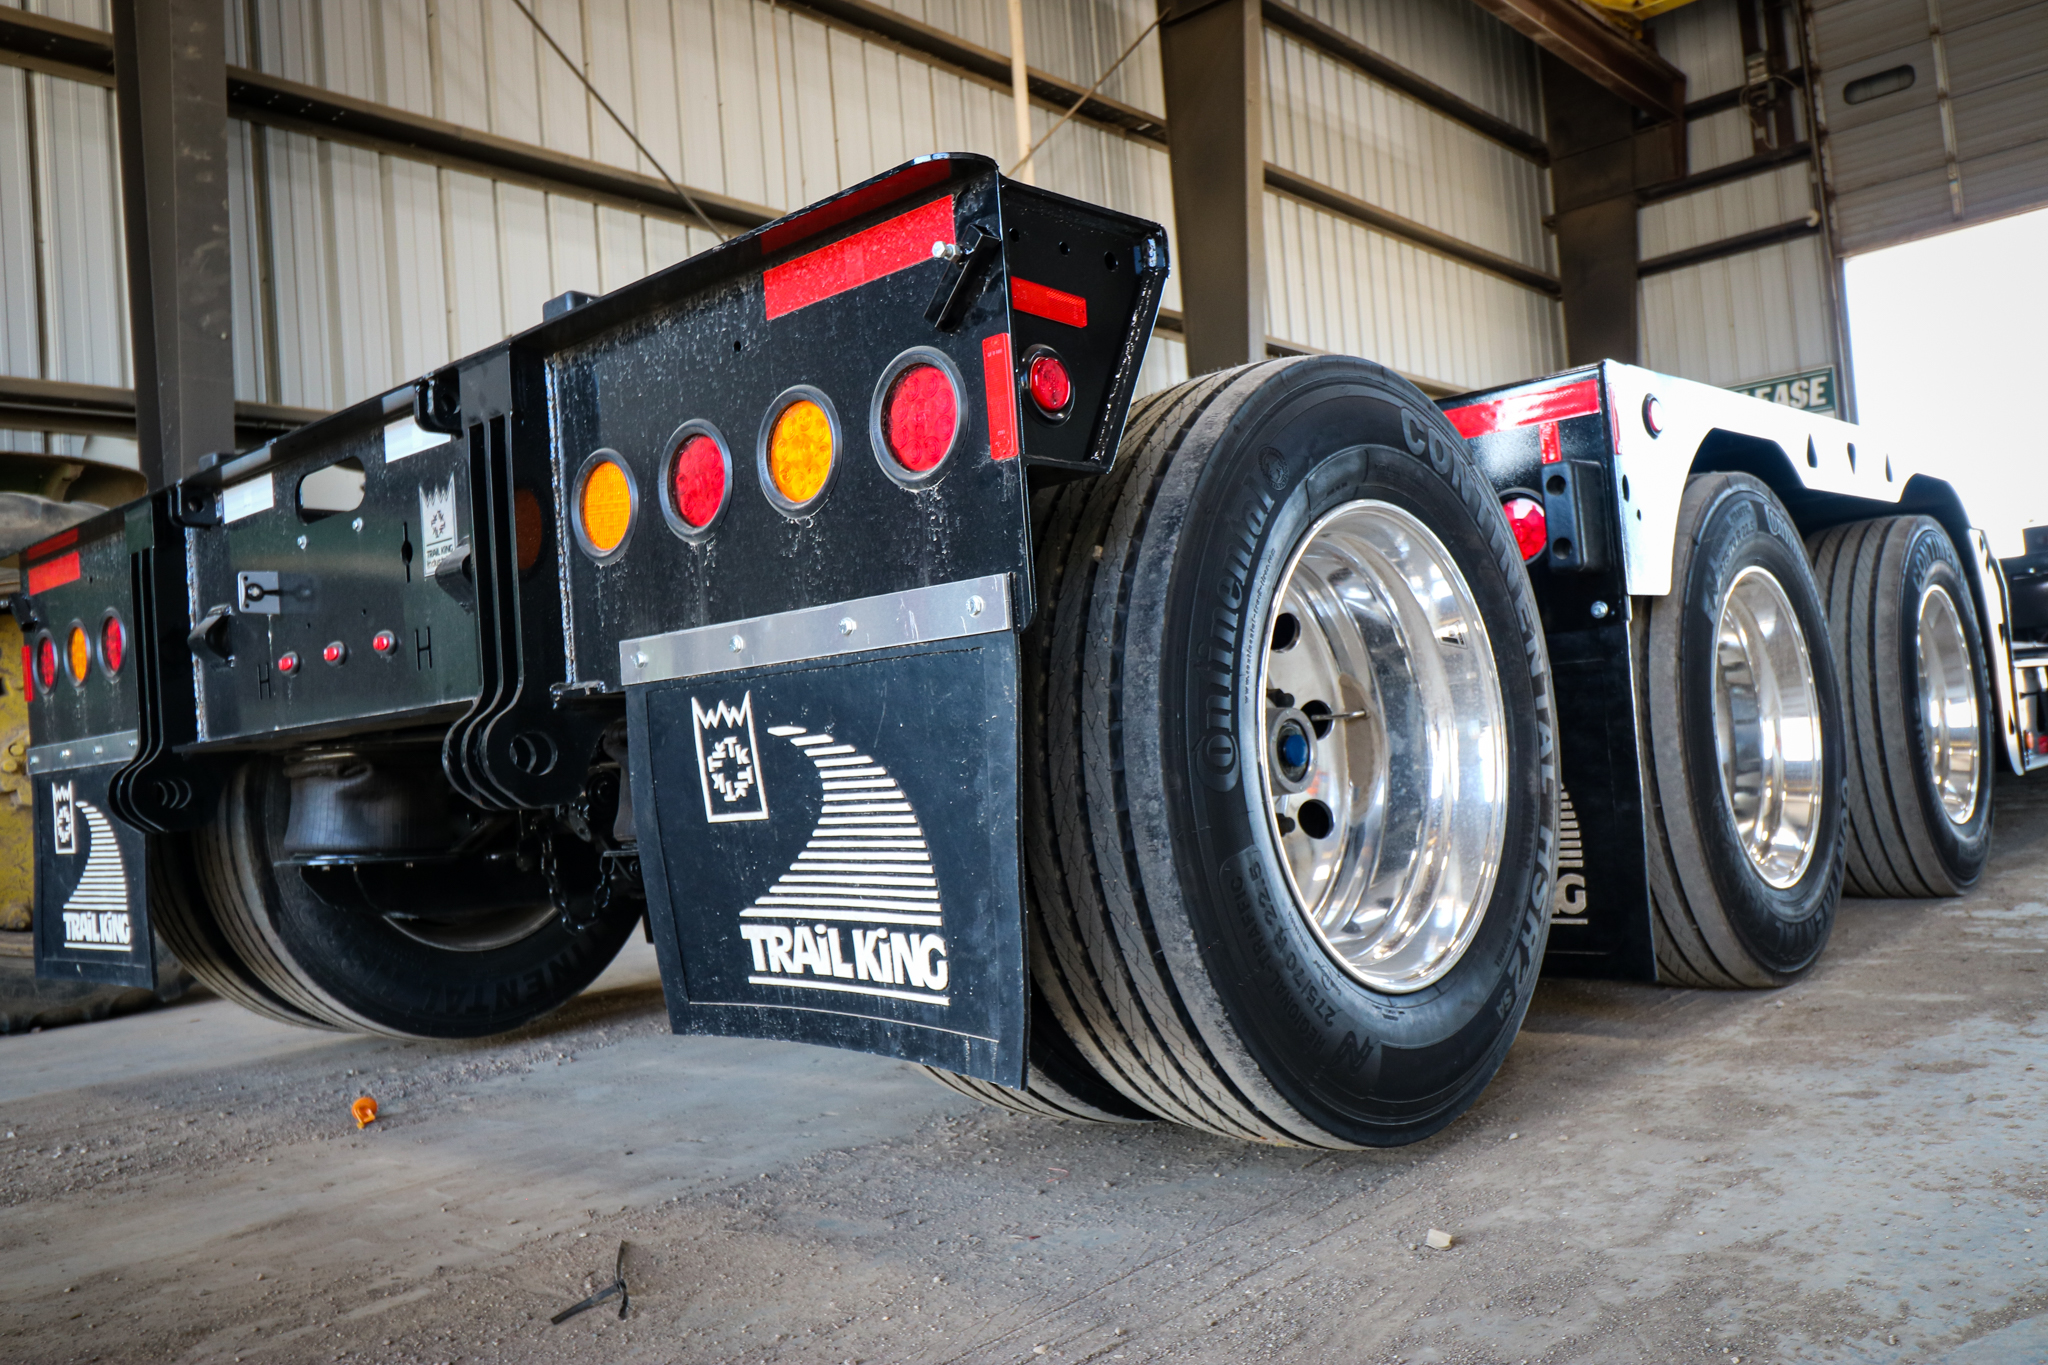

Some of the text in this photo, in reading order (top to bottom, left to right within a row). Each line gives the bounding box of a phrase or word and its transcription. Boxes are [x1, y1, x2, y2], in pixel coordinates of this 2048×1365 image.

[1196, 472, 1275, 792] Continental
[1400, 407, 1556, 794] CONTINENTAL
[1249, 861, 1279, 927] 22.5
[1507, 824, 1555, 997] HSR2
[1286, 951, 1337, 1028] 275/70
